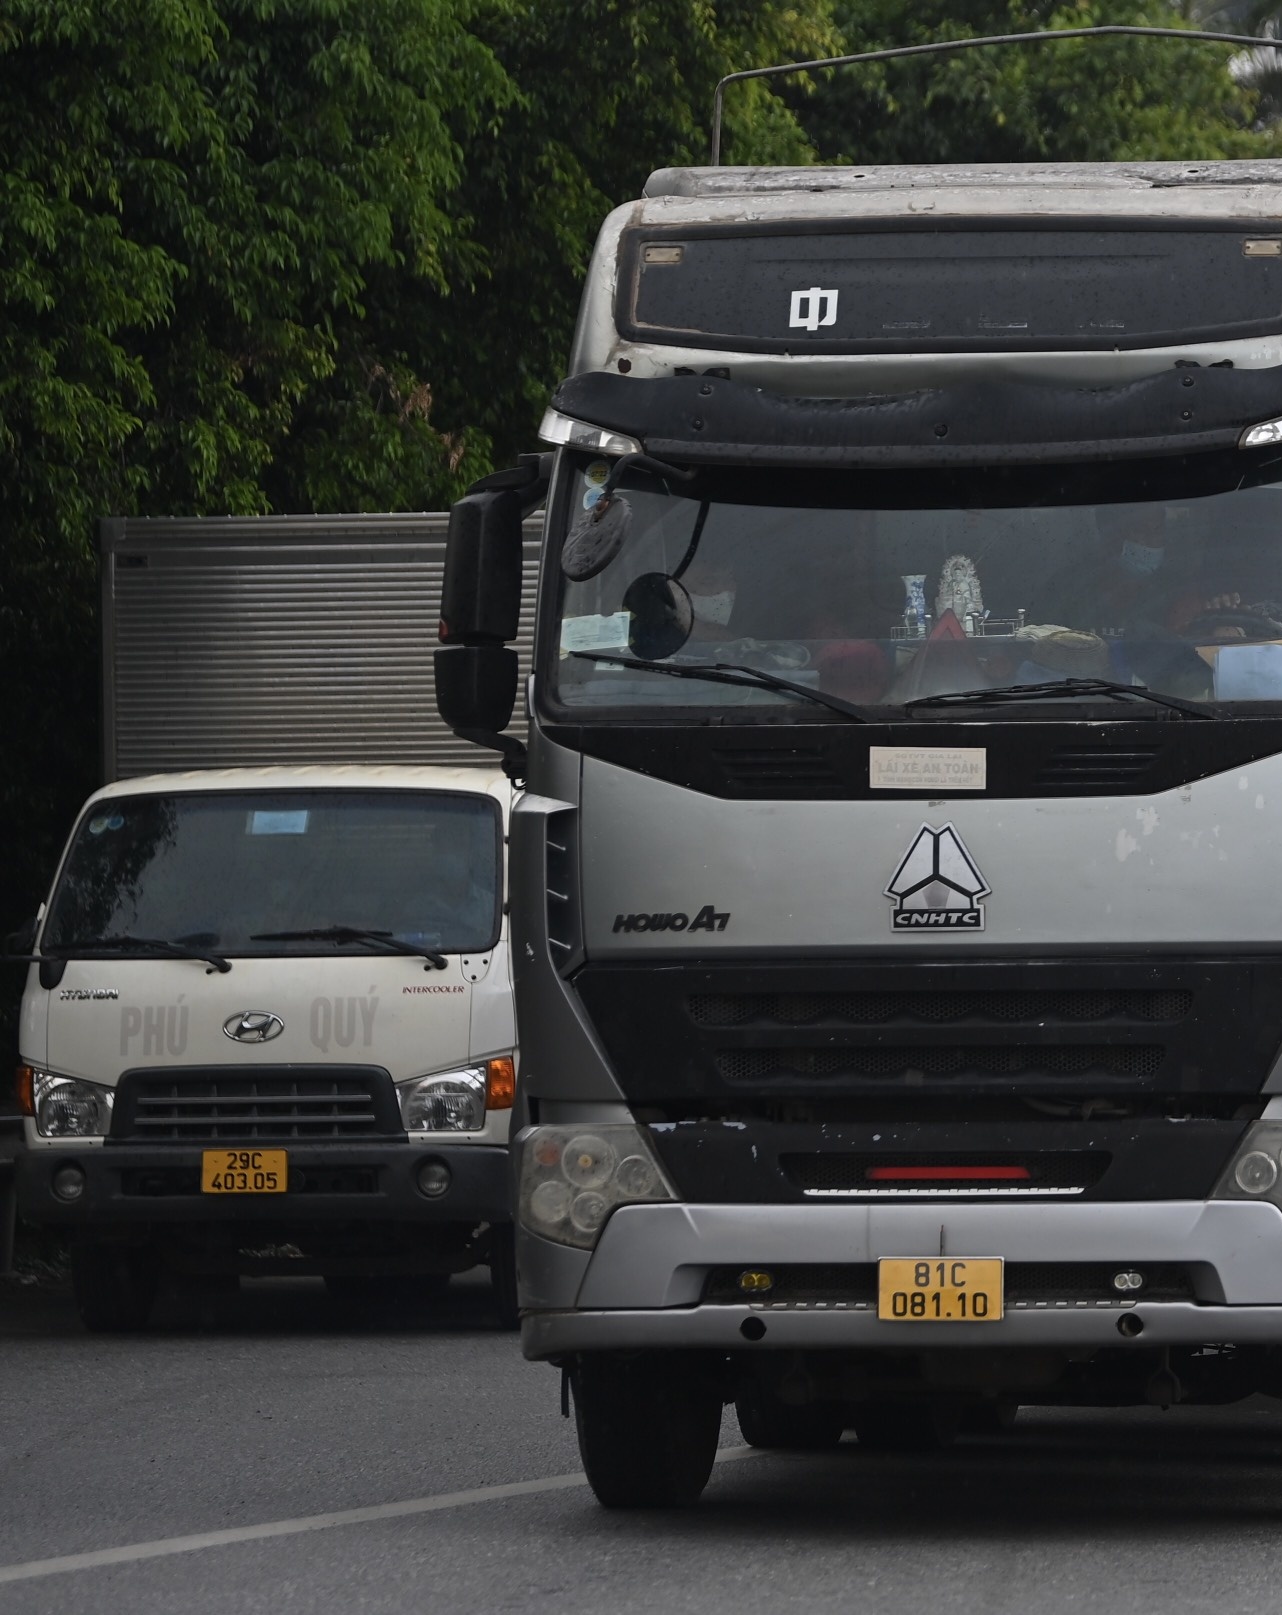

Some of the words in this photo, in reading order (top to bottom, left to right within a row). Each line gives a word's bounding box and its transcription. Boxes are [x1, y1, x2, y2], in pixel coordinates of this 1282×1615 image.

[878, 759, 899, 773] LÁI
[922, 762, 941, 774] AN
[944, 760, 979, 774] TOÀN
[612, 912, 689, 933] HOWO
[687, 905, 731, 932] A7
[895, 912, 978, 925] CNHTC
[402, 985, 465, 994] INTERCOOLER
[120, 993, 189, 1057] PHÚ
[310, 984, 379, 1053] QUÝ
[227, 1152, 262, 1170] 29C
[211, 1172, 278, 1190] 403.05
[914, 1262, 966, 1287] 81C
[892, 1291, 988, 1317] 081.10
